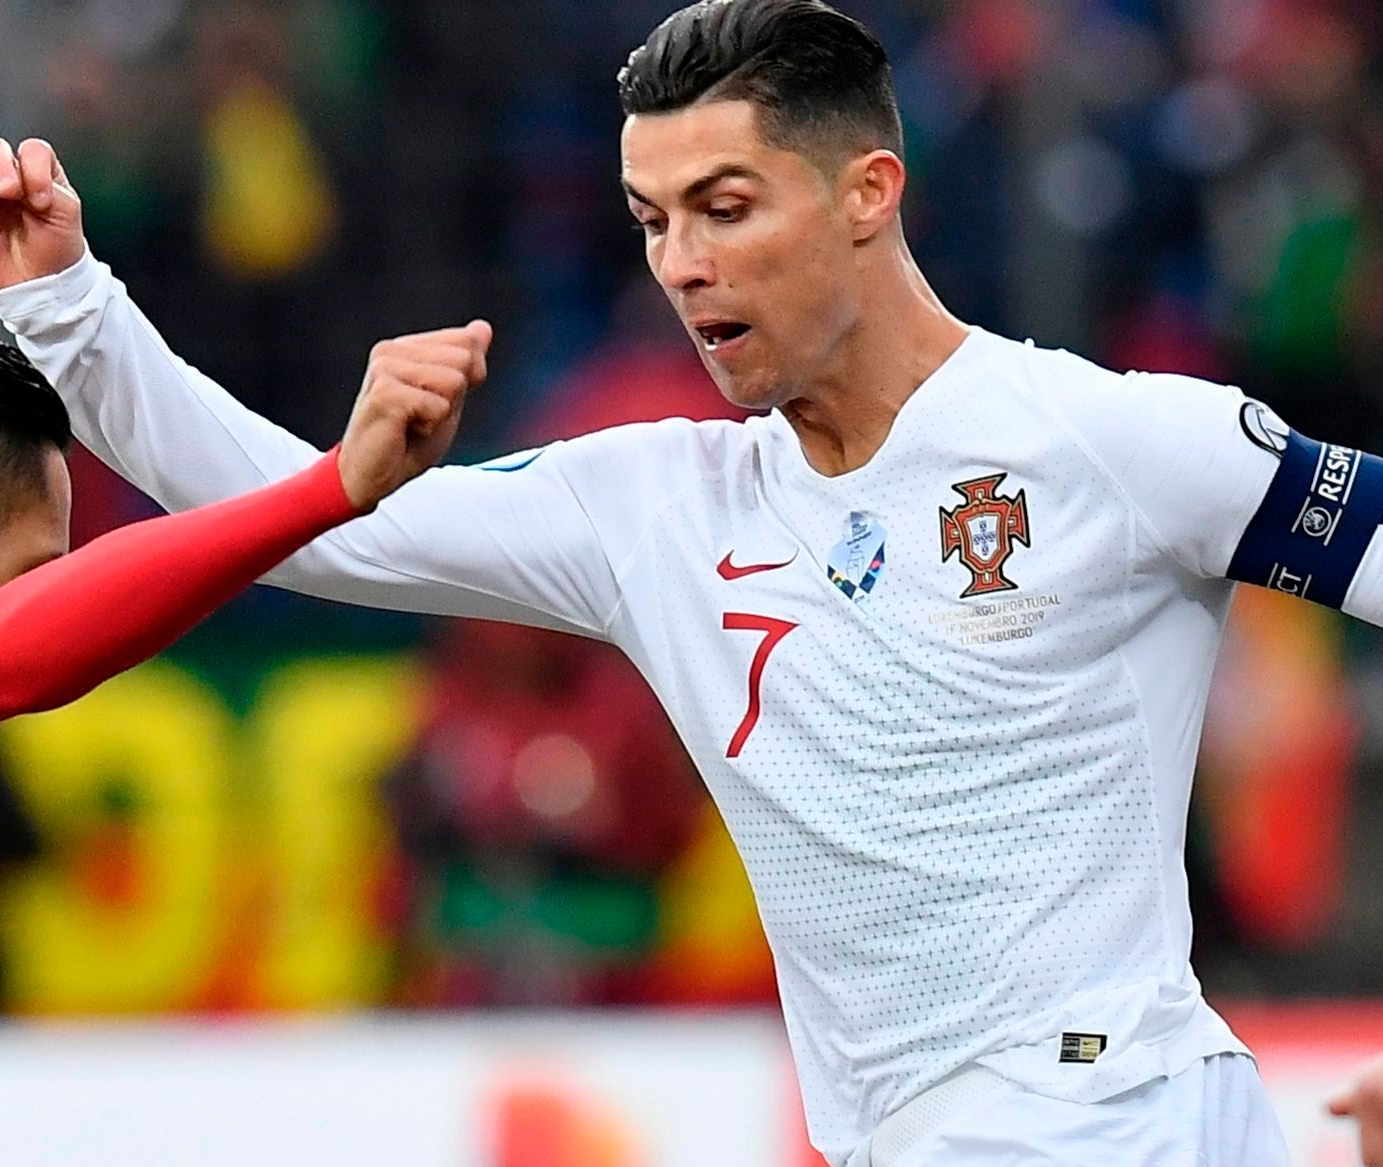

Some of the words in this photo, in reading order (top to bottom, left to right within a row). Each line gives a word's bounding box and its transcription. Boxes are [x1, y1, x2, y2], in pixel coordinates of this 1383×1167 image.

[1276, 565, 1302, 597] CT
[1020, 610, 1045, 625] 2019
[721, 612, 799, 760] 7
